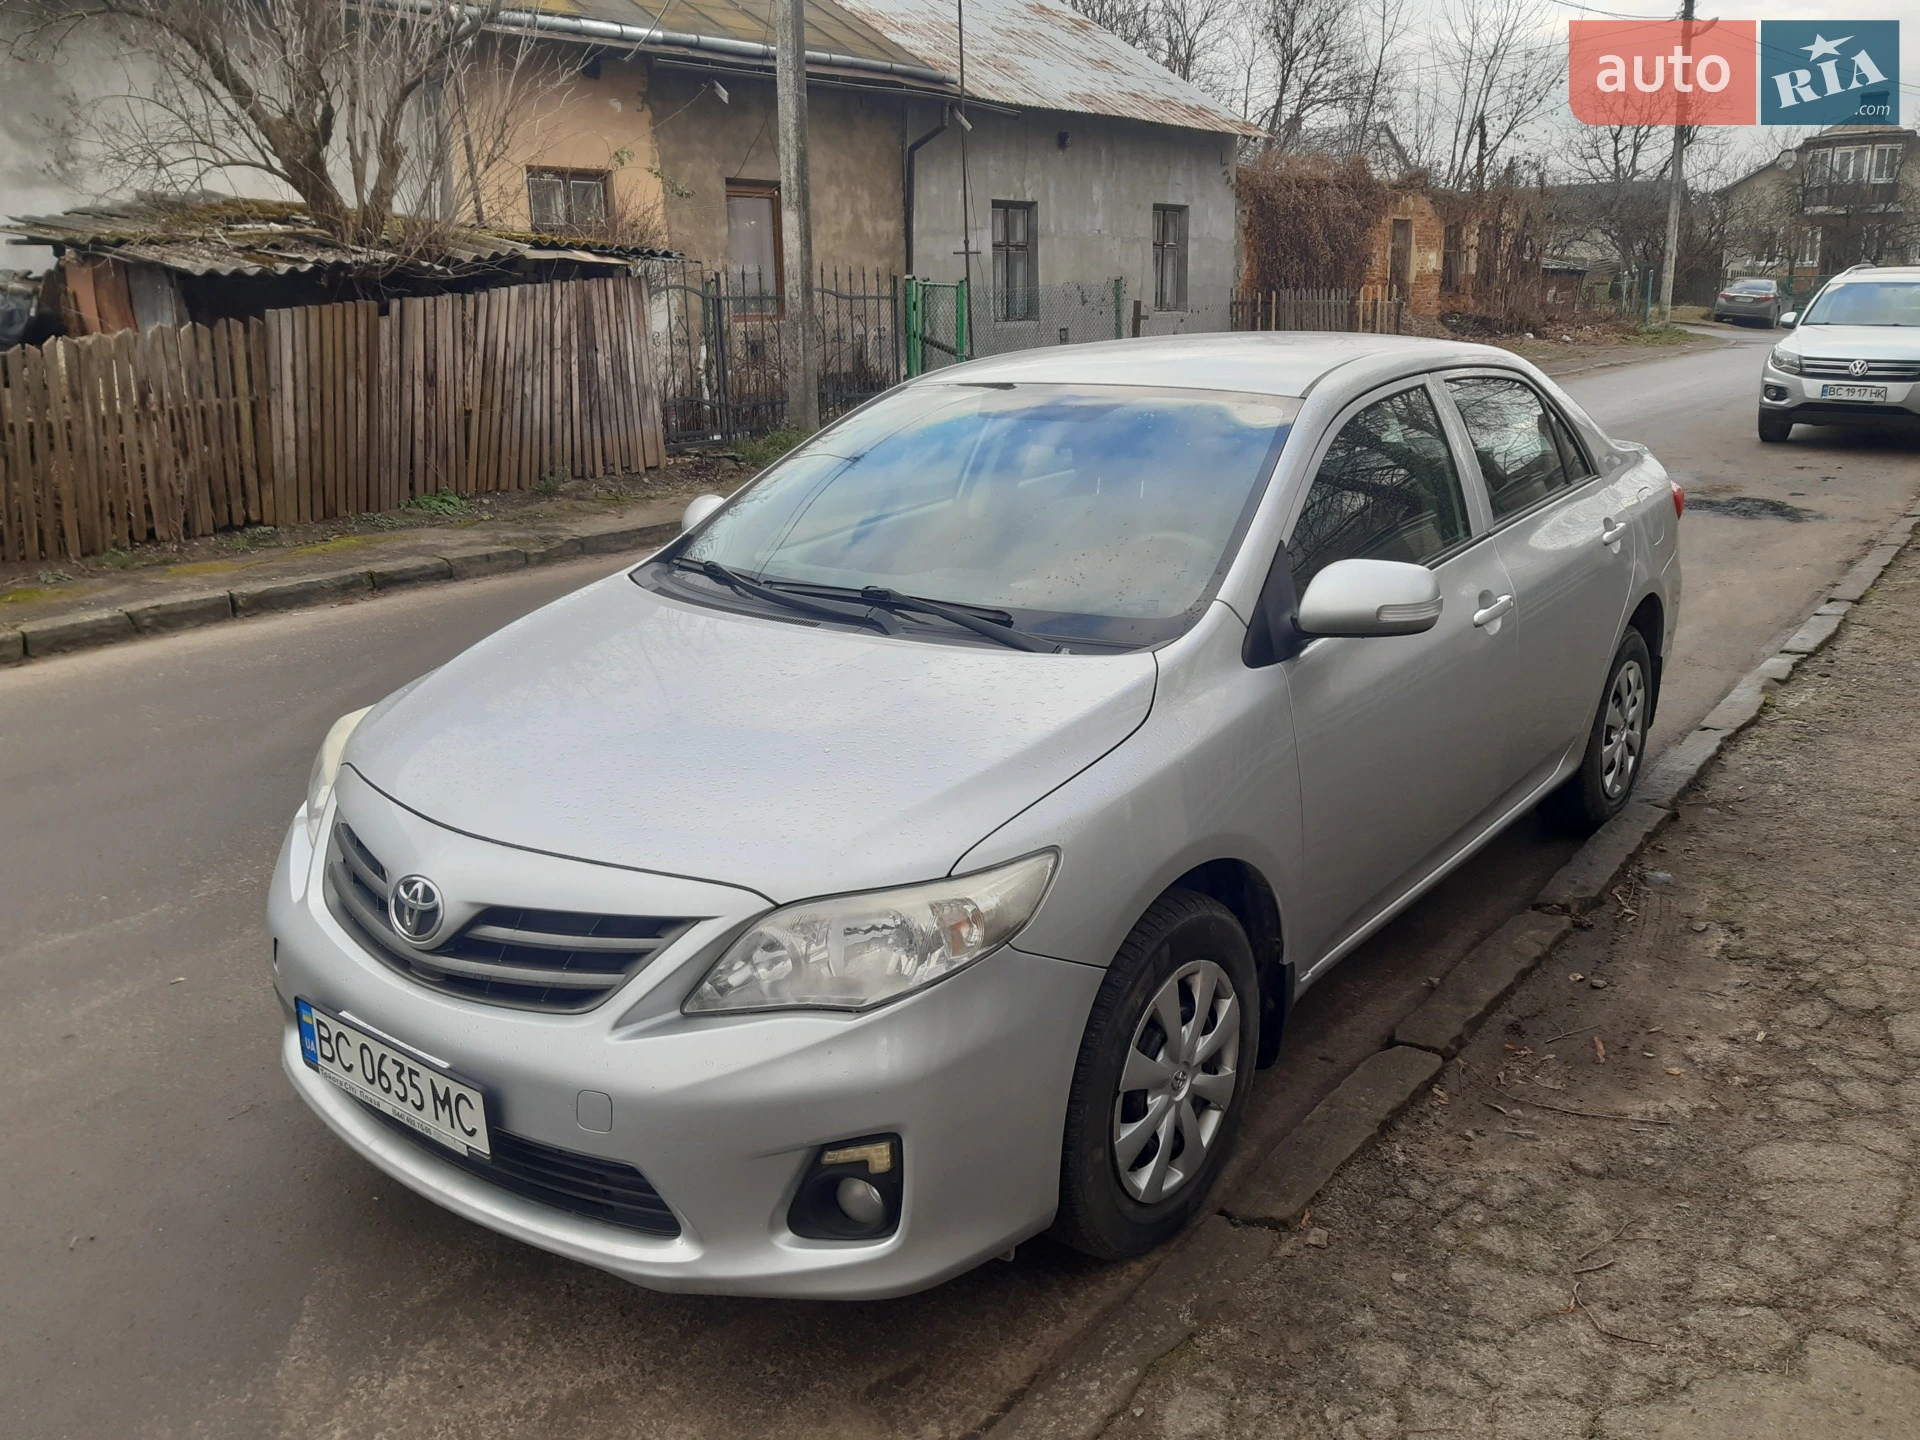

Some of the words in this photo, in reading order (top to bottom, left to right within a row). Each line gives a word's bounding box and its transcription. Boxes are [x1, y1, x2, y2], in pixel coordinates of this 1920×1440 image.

[1828, 387, 1843, 397] BC
[1845, 388, 1868, 398] 1917
[1870, 389, 1885, 399] HK
[304, 1036, 317, 1054] UA
[315, 1017, 354, 1073] BC
[359, 1042, 425, 1112] 0635
[430, 1077, 478, 1137] MC
